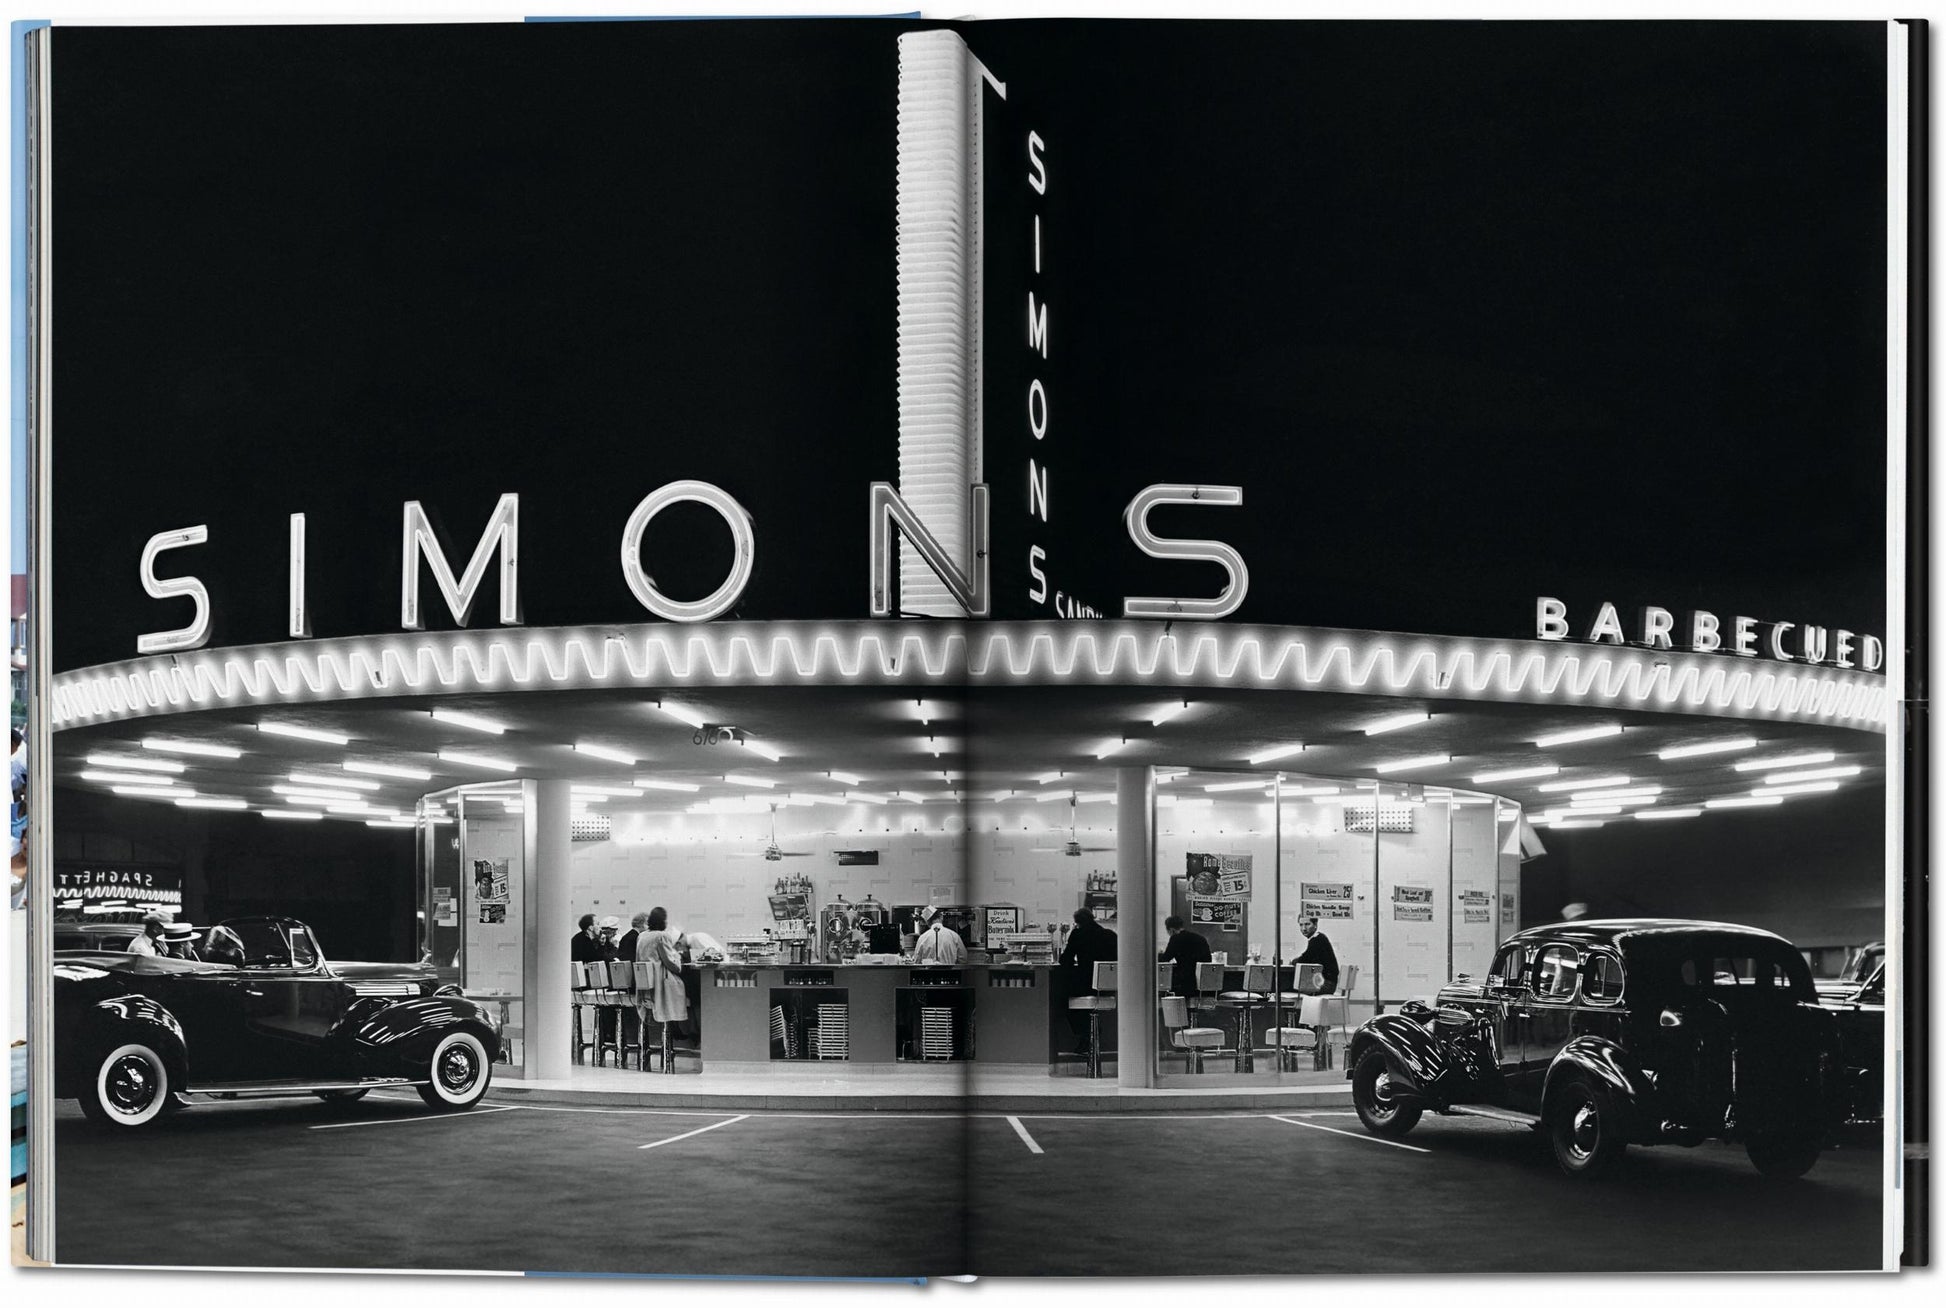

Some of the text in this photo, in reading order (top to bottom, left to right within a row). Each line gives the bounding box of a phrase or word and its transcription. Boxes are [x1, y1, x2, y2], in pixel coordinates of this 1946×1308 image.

[1028, 130, 1048, 604] SIMONS
[137, 480, 1249, 653] SIMONS
[1537, 597, 1883, 671] BARBECUED
